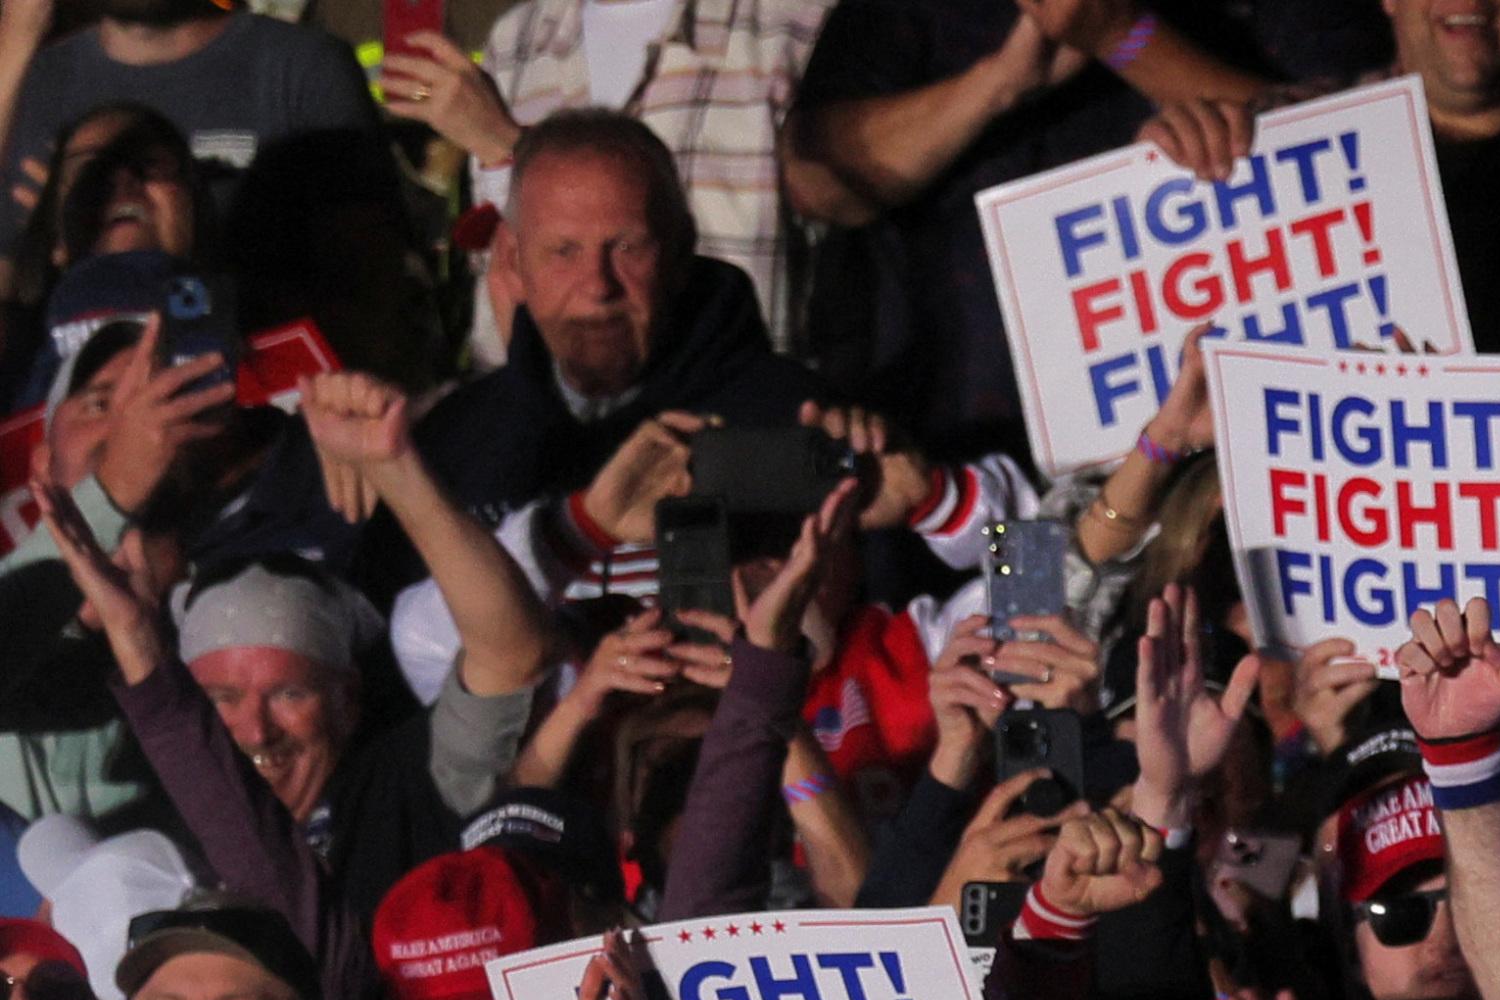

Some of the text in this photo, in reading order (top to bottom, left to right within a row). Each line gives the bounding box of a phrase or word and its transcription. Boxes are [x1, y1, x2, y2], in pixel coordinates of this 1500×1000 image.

[1055, 131, 1365, 277] FIGHT!
[1070, 201, 1382, 353] FIGHT!
[1089, 274, 1395, 427] FIHT!
